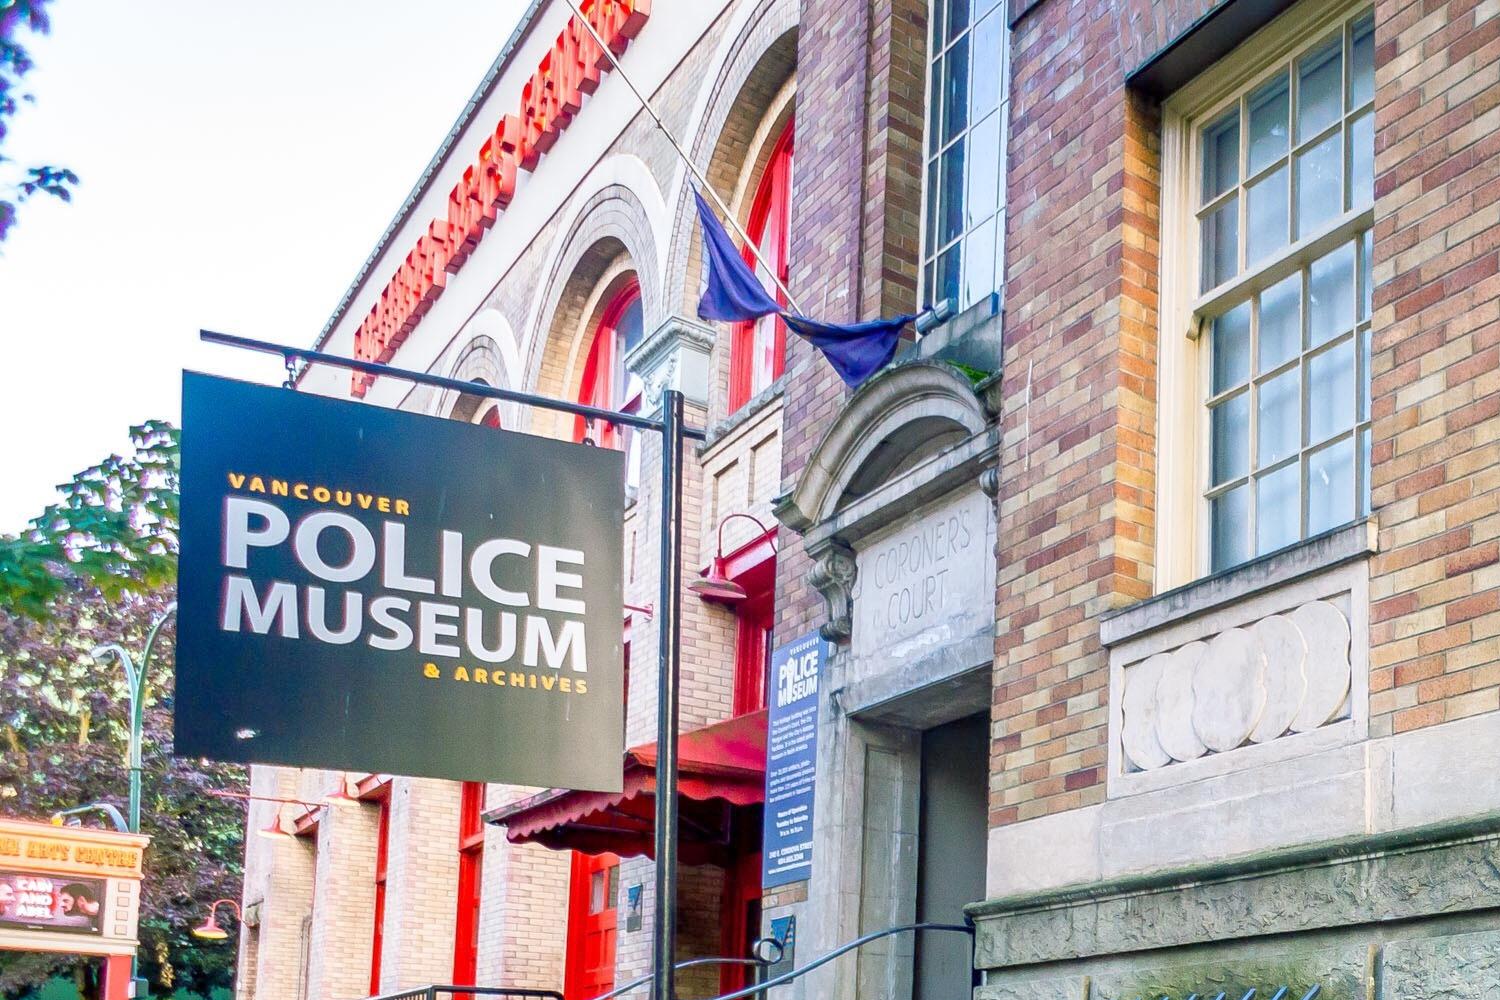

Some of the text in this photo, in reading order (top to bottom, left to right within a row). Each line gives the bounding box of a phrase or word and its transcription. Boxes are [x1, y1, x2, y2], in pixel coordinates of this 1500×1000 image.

[228, 472, 411, 516] VANCOUVER
[225, 497, 586, 614] POLICE
[875, 508, 972, 589] CORONER'S
[223, 575, 588, 672] MUSEUM
[888, 569, 949, 629] COURT
[423, 663, 588, 694] & ARCHIVES
[778, 675, 817, 707] MUSEUM
[779, 650, 818, 688] POLICE
